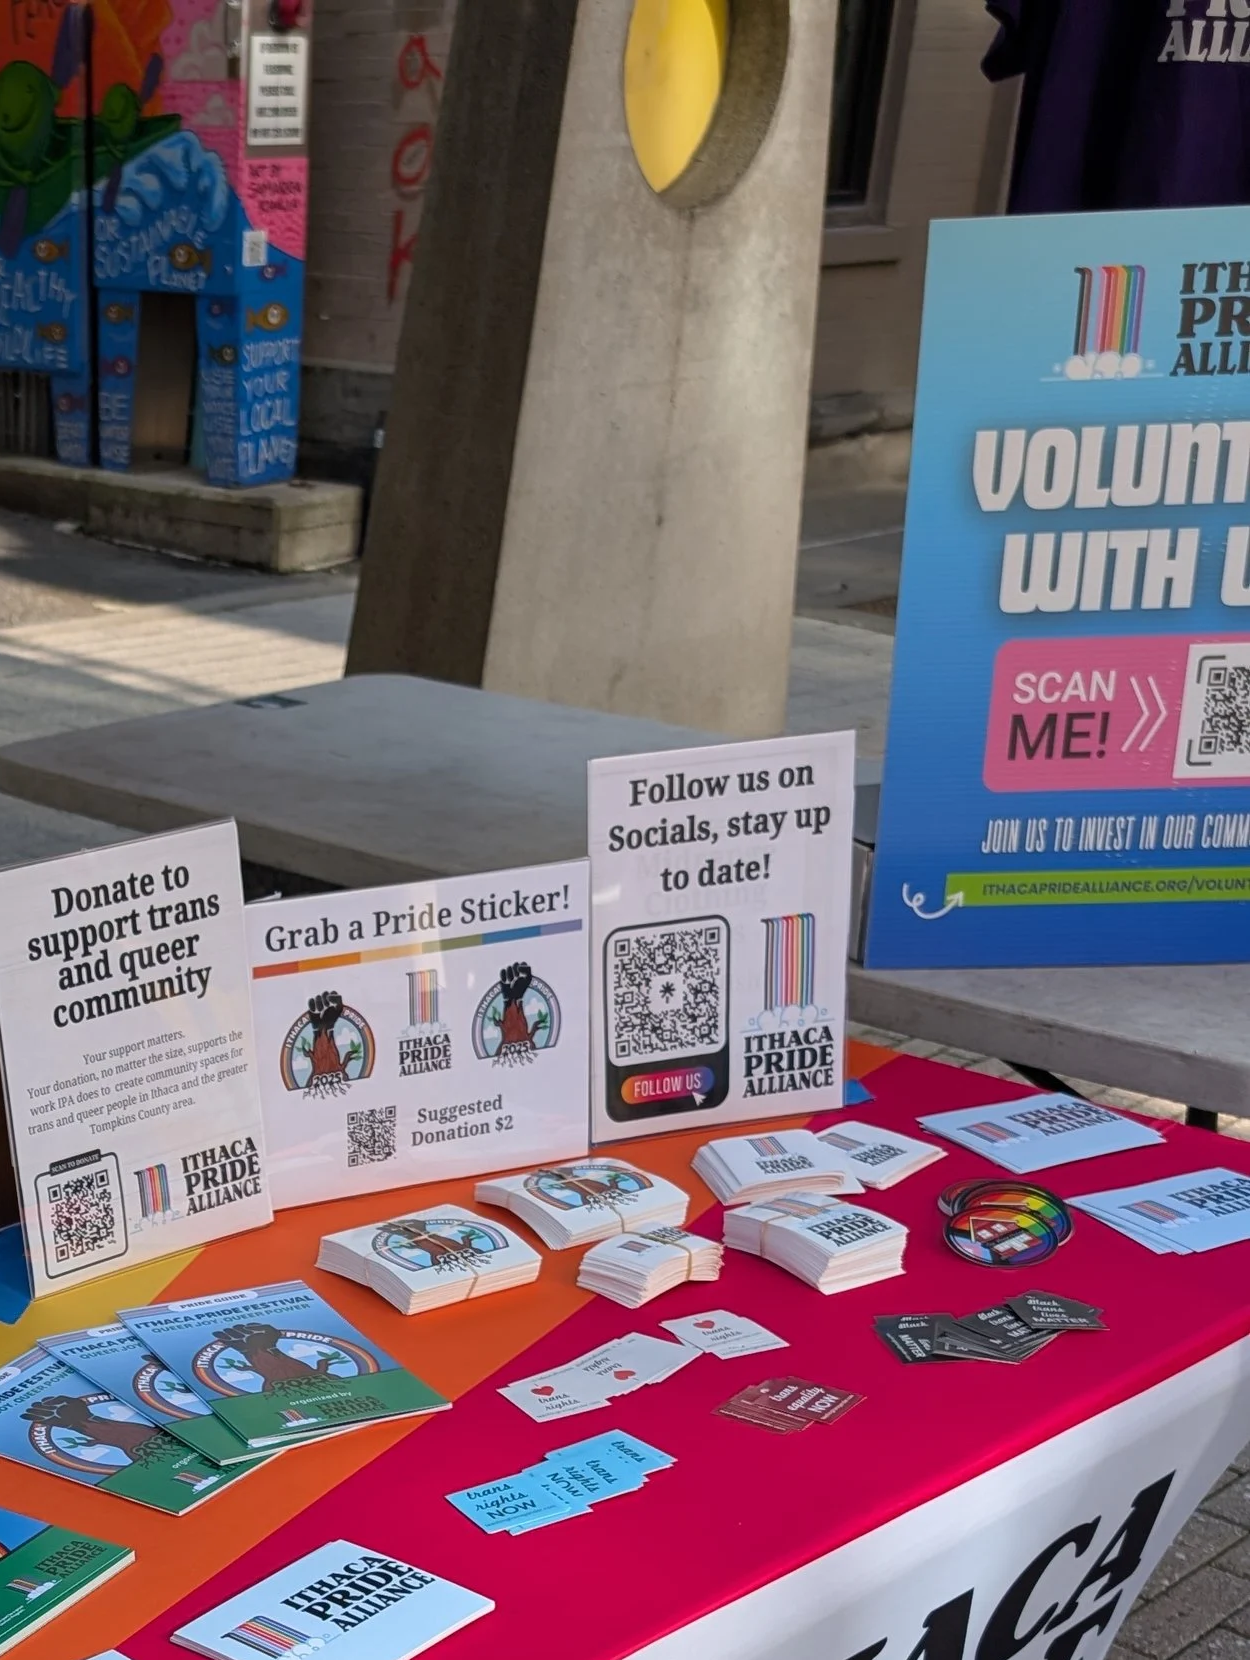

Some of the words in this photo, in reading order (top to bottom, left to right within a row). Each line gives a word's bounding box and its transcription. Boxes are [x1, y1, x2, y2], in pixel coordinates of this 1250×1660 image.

[241, 337, 299, 373] SUPPORT
[244, 371, 291, 402] YOUR
[239, 399, 296, 437] LOCAL
[238, 436, 298, 480] PLANET
[999, 527, 1200, 613] WITH
[1012, 670, 1116, 704] SCAN
[1007, 711, 1110, 761] ME!
[629, 773, 730, 806] Follow
[737, 770, 769, 793] us
[778, 765, 814, 788] on
[608, 814, 718, 852] Socials,
[727, 811, 787, 840] stay
[794, 806, 830, 834] up
[981, 818, 1021, 854] JOIN
[1025, 818, 1048, 852] US
[1054, 817, 1074, 851] TO
[1078, 815, 1136, 851] INVEST
[1139, 815, 1158, 850] IN
[1162, 814, 1196, 849] OUR
[660, 868, 689, 891] to
[698, 853, 769, 886] date!
[51, 873, 154, 917] Donate
[161, 865, 189, 891] to
[27, 909, 141, 962] support
[147, 894, 219, 930] trans
[265, 917, 338, 952] Grab
[348, 920, 364, 940] a
[373, 903, 451, 937] Pride
[460, 884, 568, 924] Sticker!
[58, 951, 112, 990] and
[119, 934, 199, 981] queer
[53, 966, 212, 1027] community
[82, 1051, 107, 1065] Your
[108, 1039, 145, 1058] support
[146, 1030, 185, 1047] matters.
[399, 1033, 450, 1051] ITHACA
[399, 1044, 451, 1064] PRIDE
[745, 1025, 833, 1053] ITHACA
[399, 1057, 451, 1077] ALLIANCE
[744, 1043, 834, 1077] PRIDE
[634, 1076, 681, 1096] FOLLOW
[686, 1072, 701, 1089] US
[742, 1067, 833, 1098] ALLIANCE
[88, 1113, 136, 1134] Tompkins
[137, 1103, 170, 1120] County
[172, 1097, 195, 1110] area.
[417, 1093, 502, 1124] Suggested
[411, 1121, 490, 1146] Donation
[494, 1114, 513, 1131] $2
[181, 1136, 257, 1173] ITHACA
[185, 1152, 261, 1195] PRIDE
[186, 1175, 261, 1216] ALLIANCE
[467, 1482, 514, 1500] trans
[475, 1491, 529, 1512] rights
[486, 1500, 537, 1520] NOW
[280, 1555, 381, 1611] ITHACA
[302, 1562, 412, 1621] PRIDE
[332, 1568, 436, 1633] ALLIANCE
